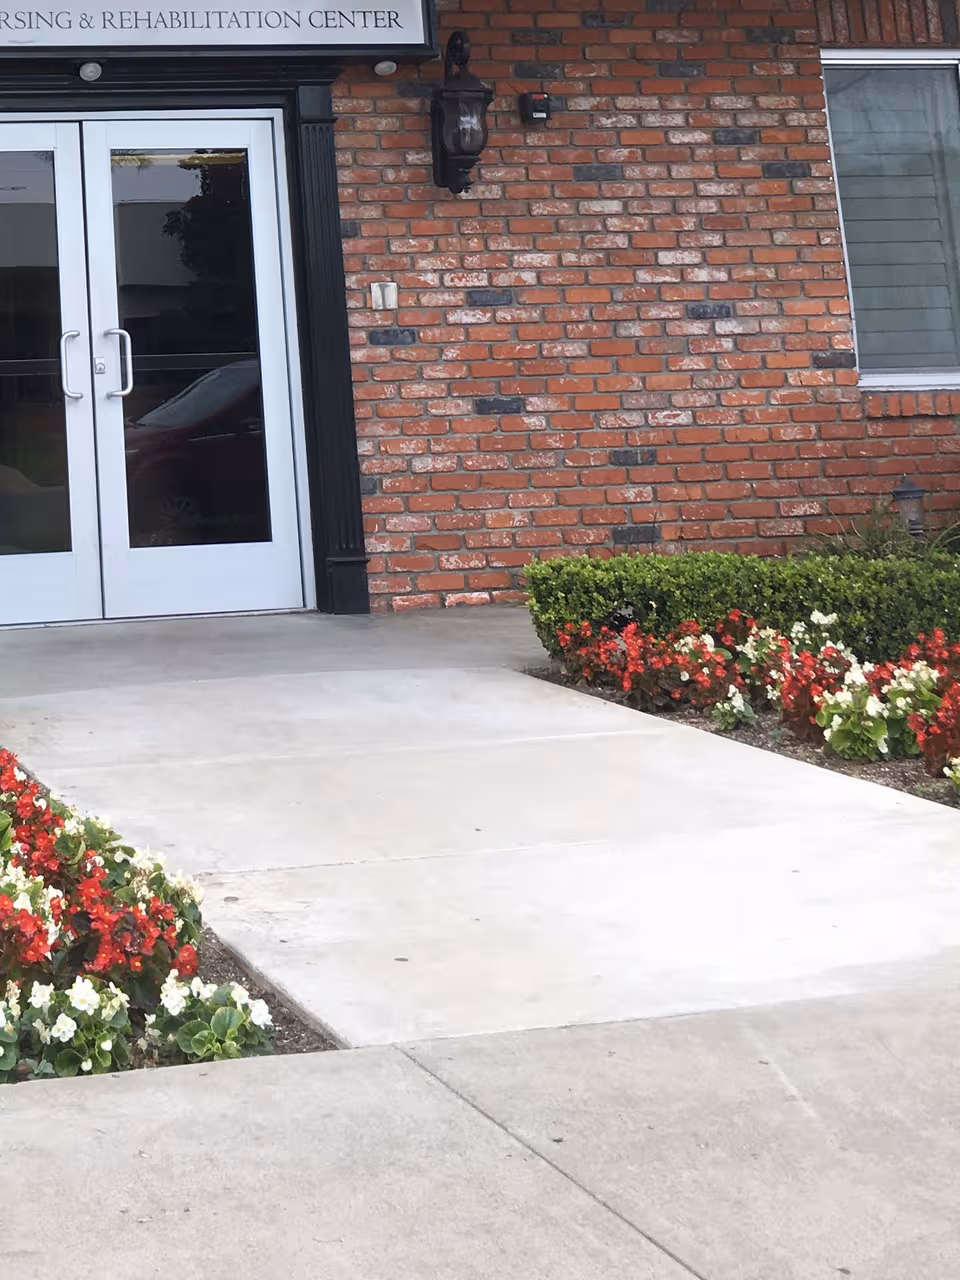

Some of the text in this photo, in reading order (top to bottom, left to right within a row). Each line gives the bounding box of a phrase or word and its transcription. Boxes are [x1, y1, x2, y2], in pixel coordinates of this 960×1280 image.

[78, 11, 95, 29] &
[102, 9, 303, 30] REHABILITATION
[308, 9, 404, 30] CENTER
